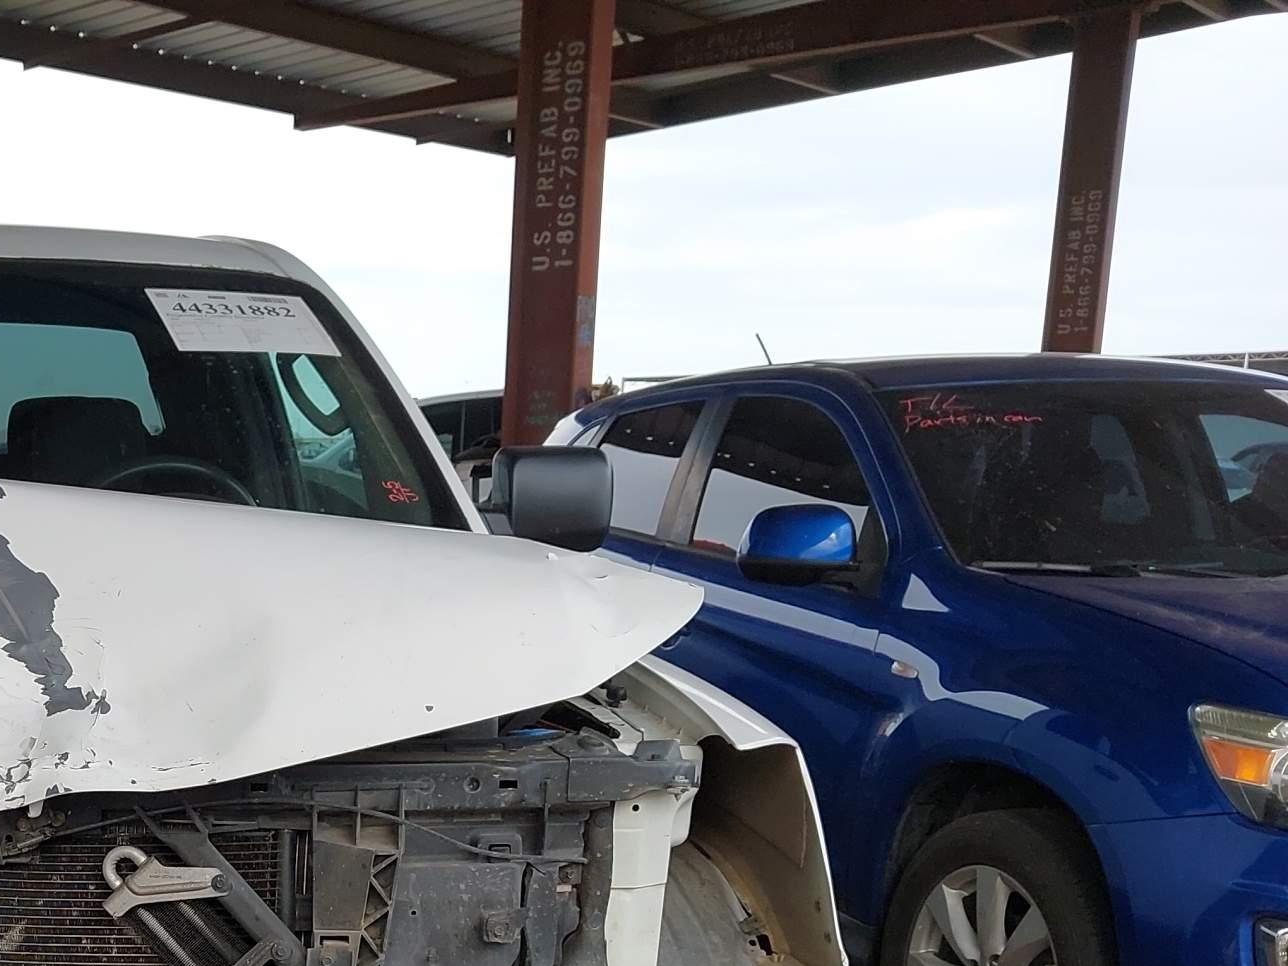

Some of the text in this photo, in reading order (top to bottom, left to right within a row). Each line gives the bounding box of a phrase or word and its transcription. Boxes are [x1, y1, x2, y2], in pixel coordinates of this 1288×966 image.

[531, 40, 564, 273] U.S. PREFAB INC.
[553, 40, 586, 269] 1-866-799-0969
[1061, 230, 1082, 295] PREFAB
[172, 301, 297, 318] 44331882
[975, 412, 997, 424] in
